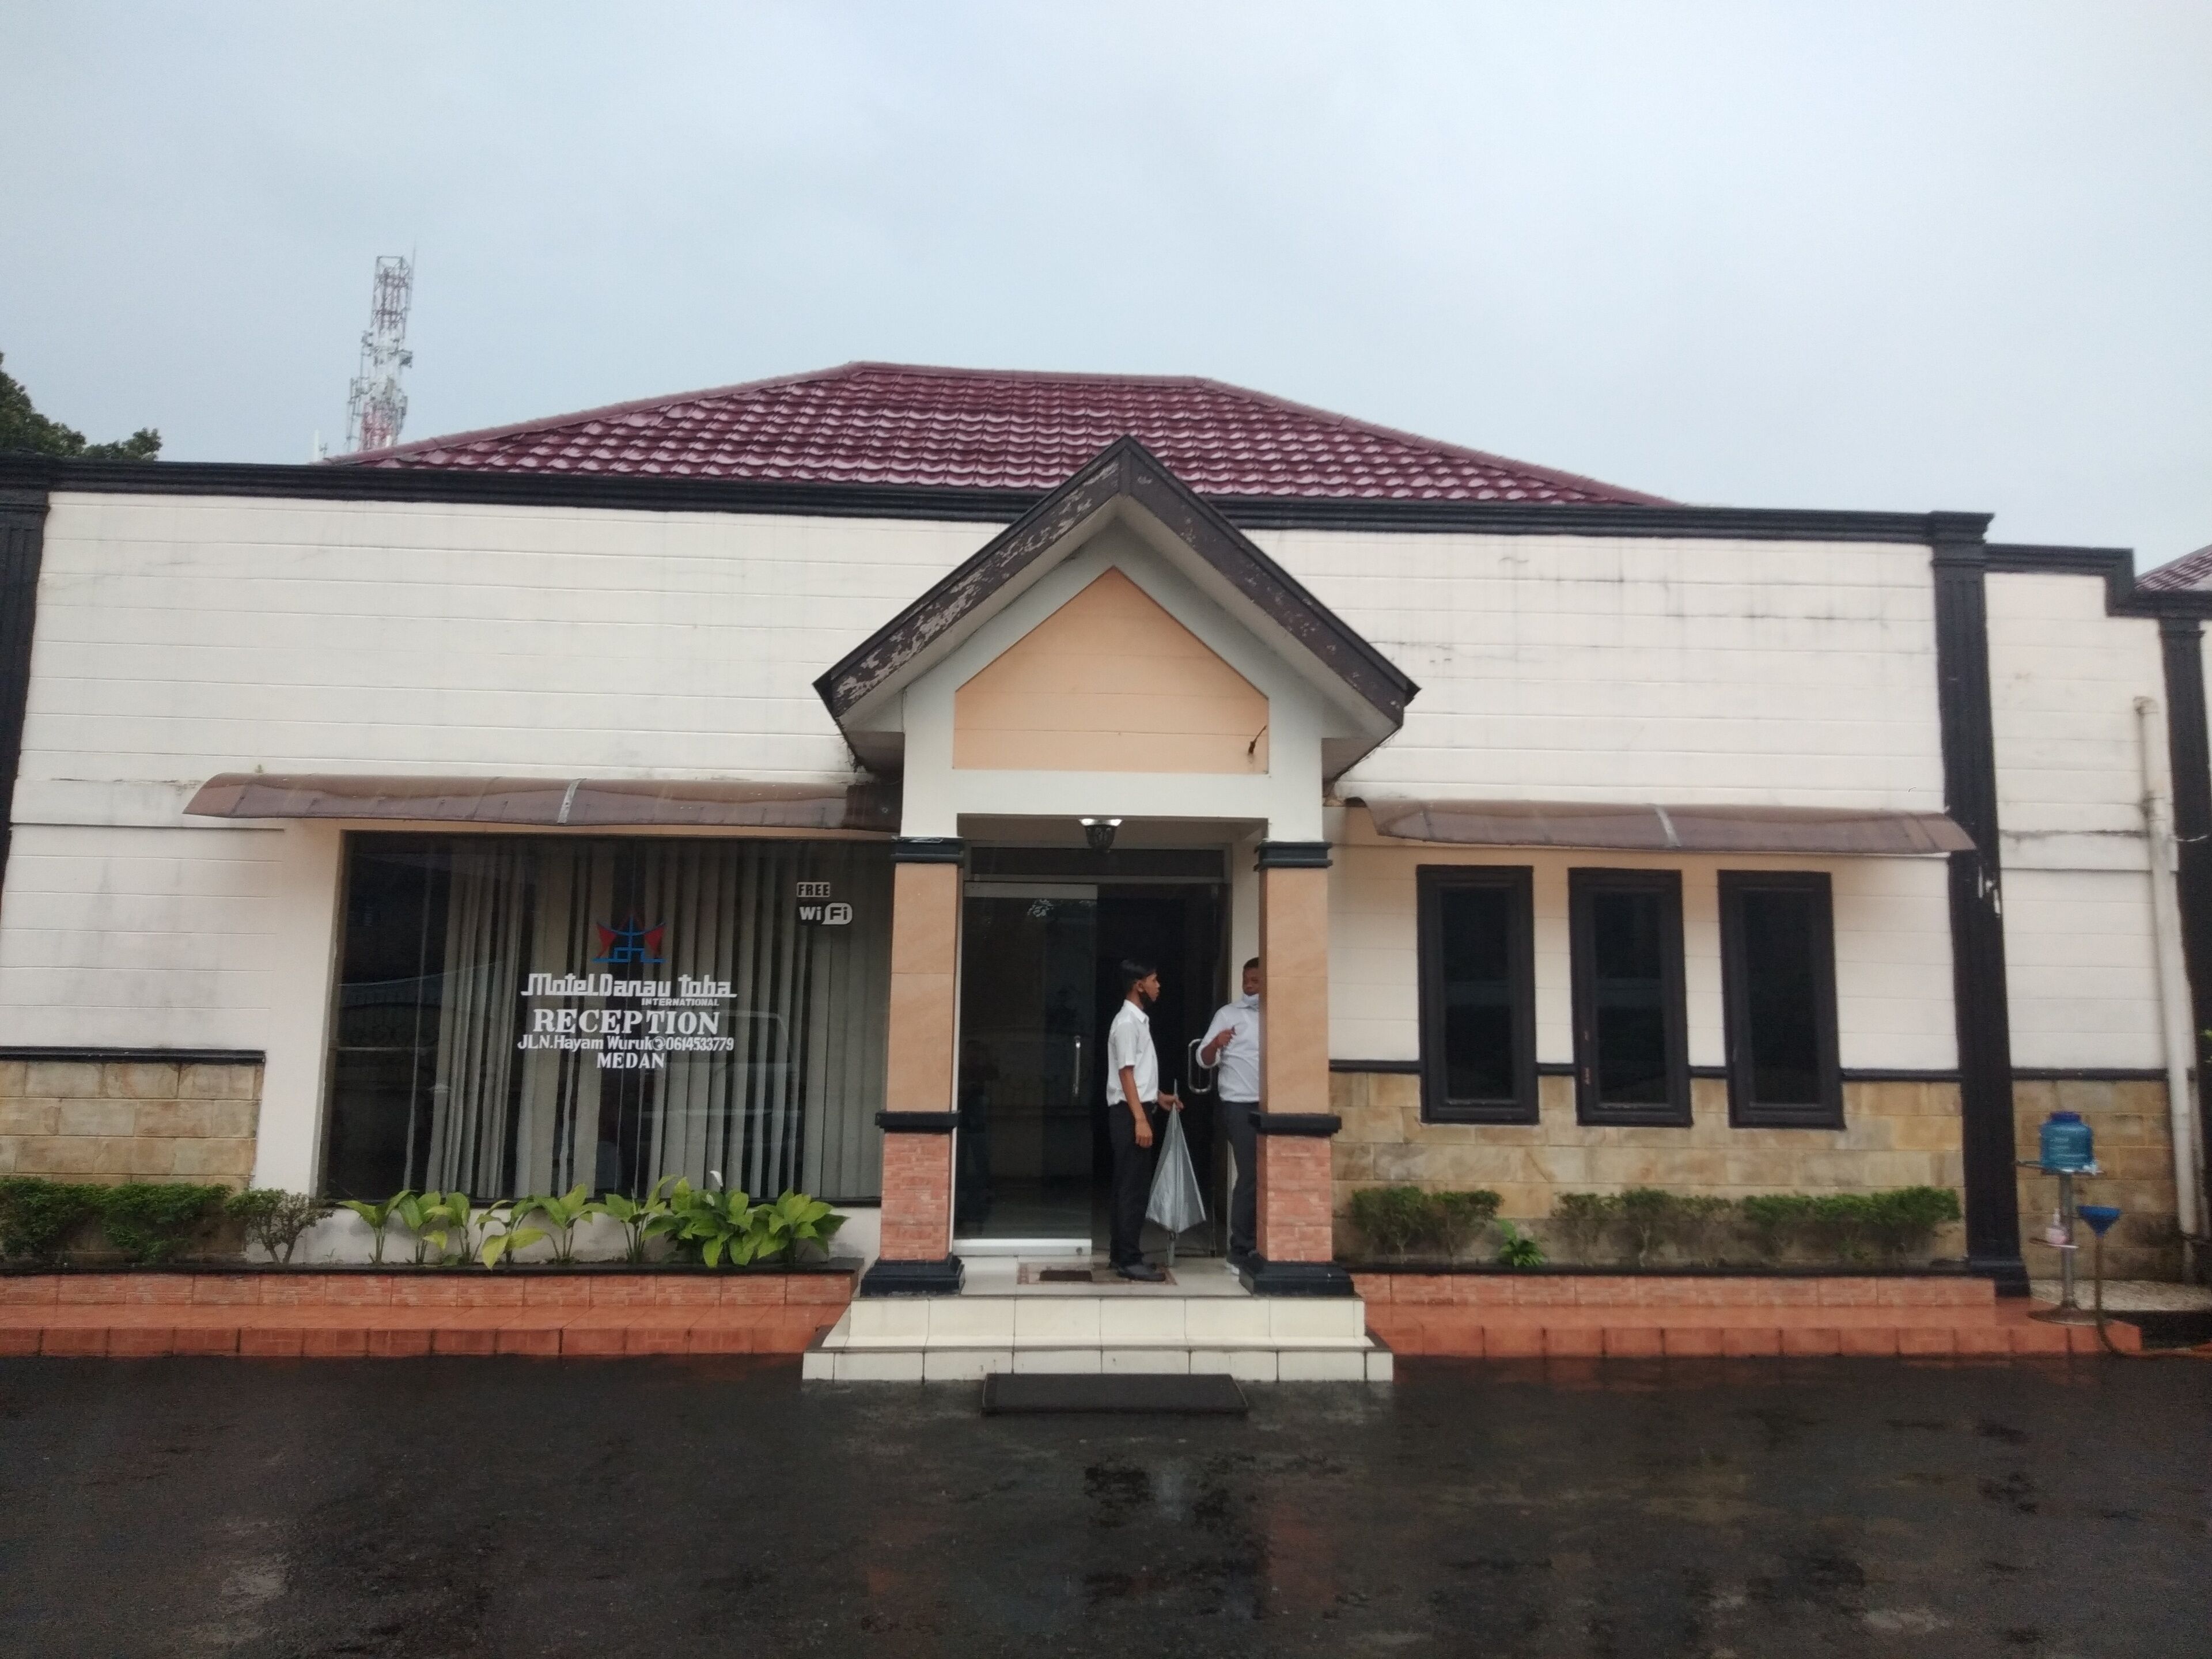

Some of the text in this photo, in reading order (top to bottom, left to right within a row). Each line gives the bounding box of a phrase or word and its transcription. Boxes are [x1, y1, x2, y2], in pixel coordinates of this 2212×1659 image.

[798, 884, 830, 896] FREE
[600, 974, 672, 997] Danau
[641, 998, 720, 1006] INTERNATIONAL
[533, 1009, 720, 1035] RECEPTION
[596, 1052, 665, 1069] MEDAN
